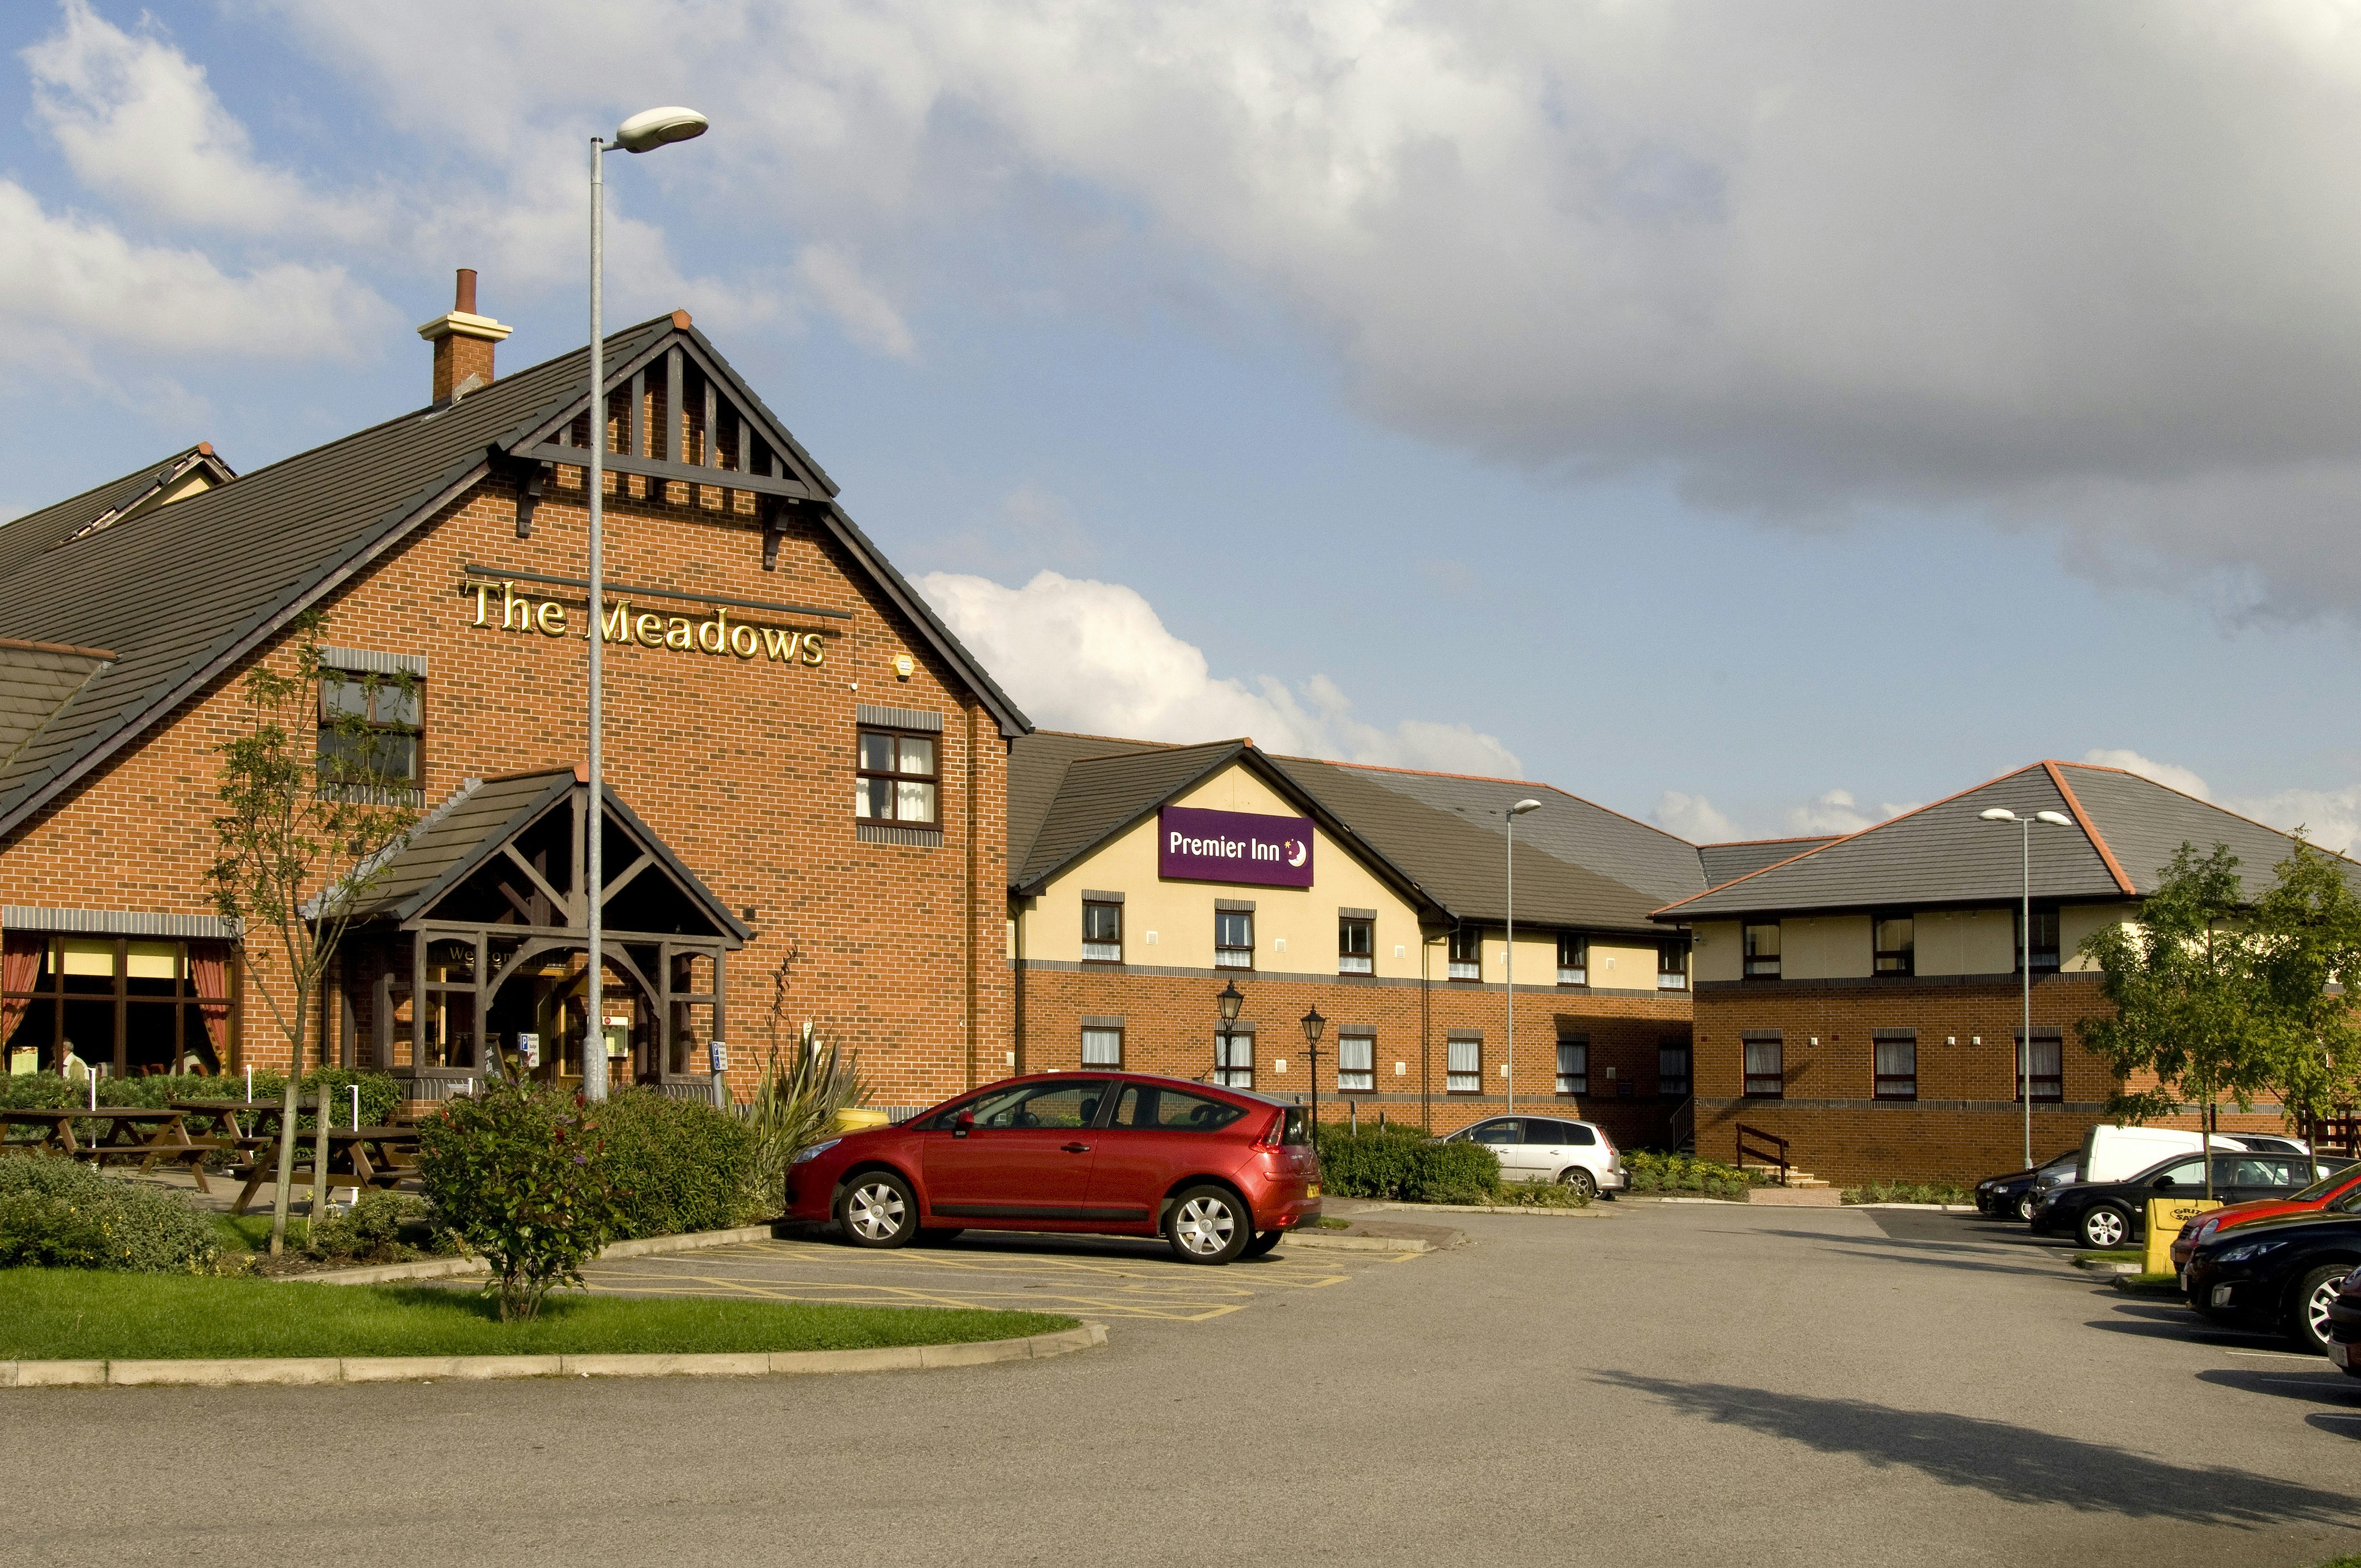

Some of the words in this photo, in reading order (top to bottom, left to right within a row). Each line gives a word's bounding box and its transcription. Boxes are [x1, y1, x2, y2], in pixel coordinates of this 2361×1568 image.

[464, 580, 567, 637] The
[583, 595, 825, 667] Meadows
[1170, 831, 1246, 858] Premier
[1252, 838, 1280, 861] Inn
